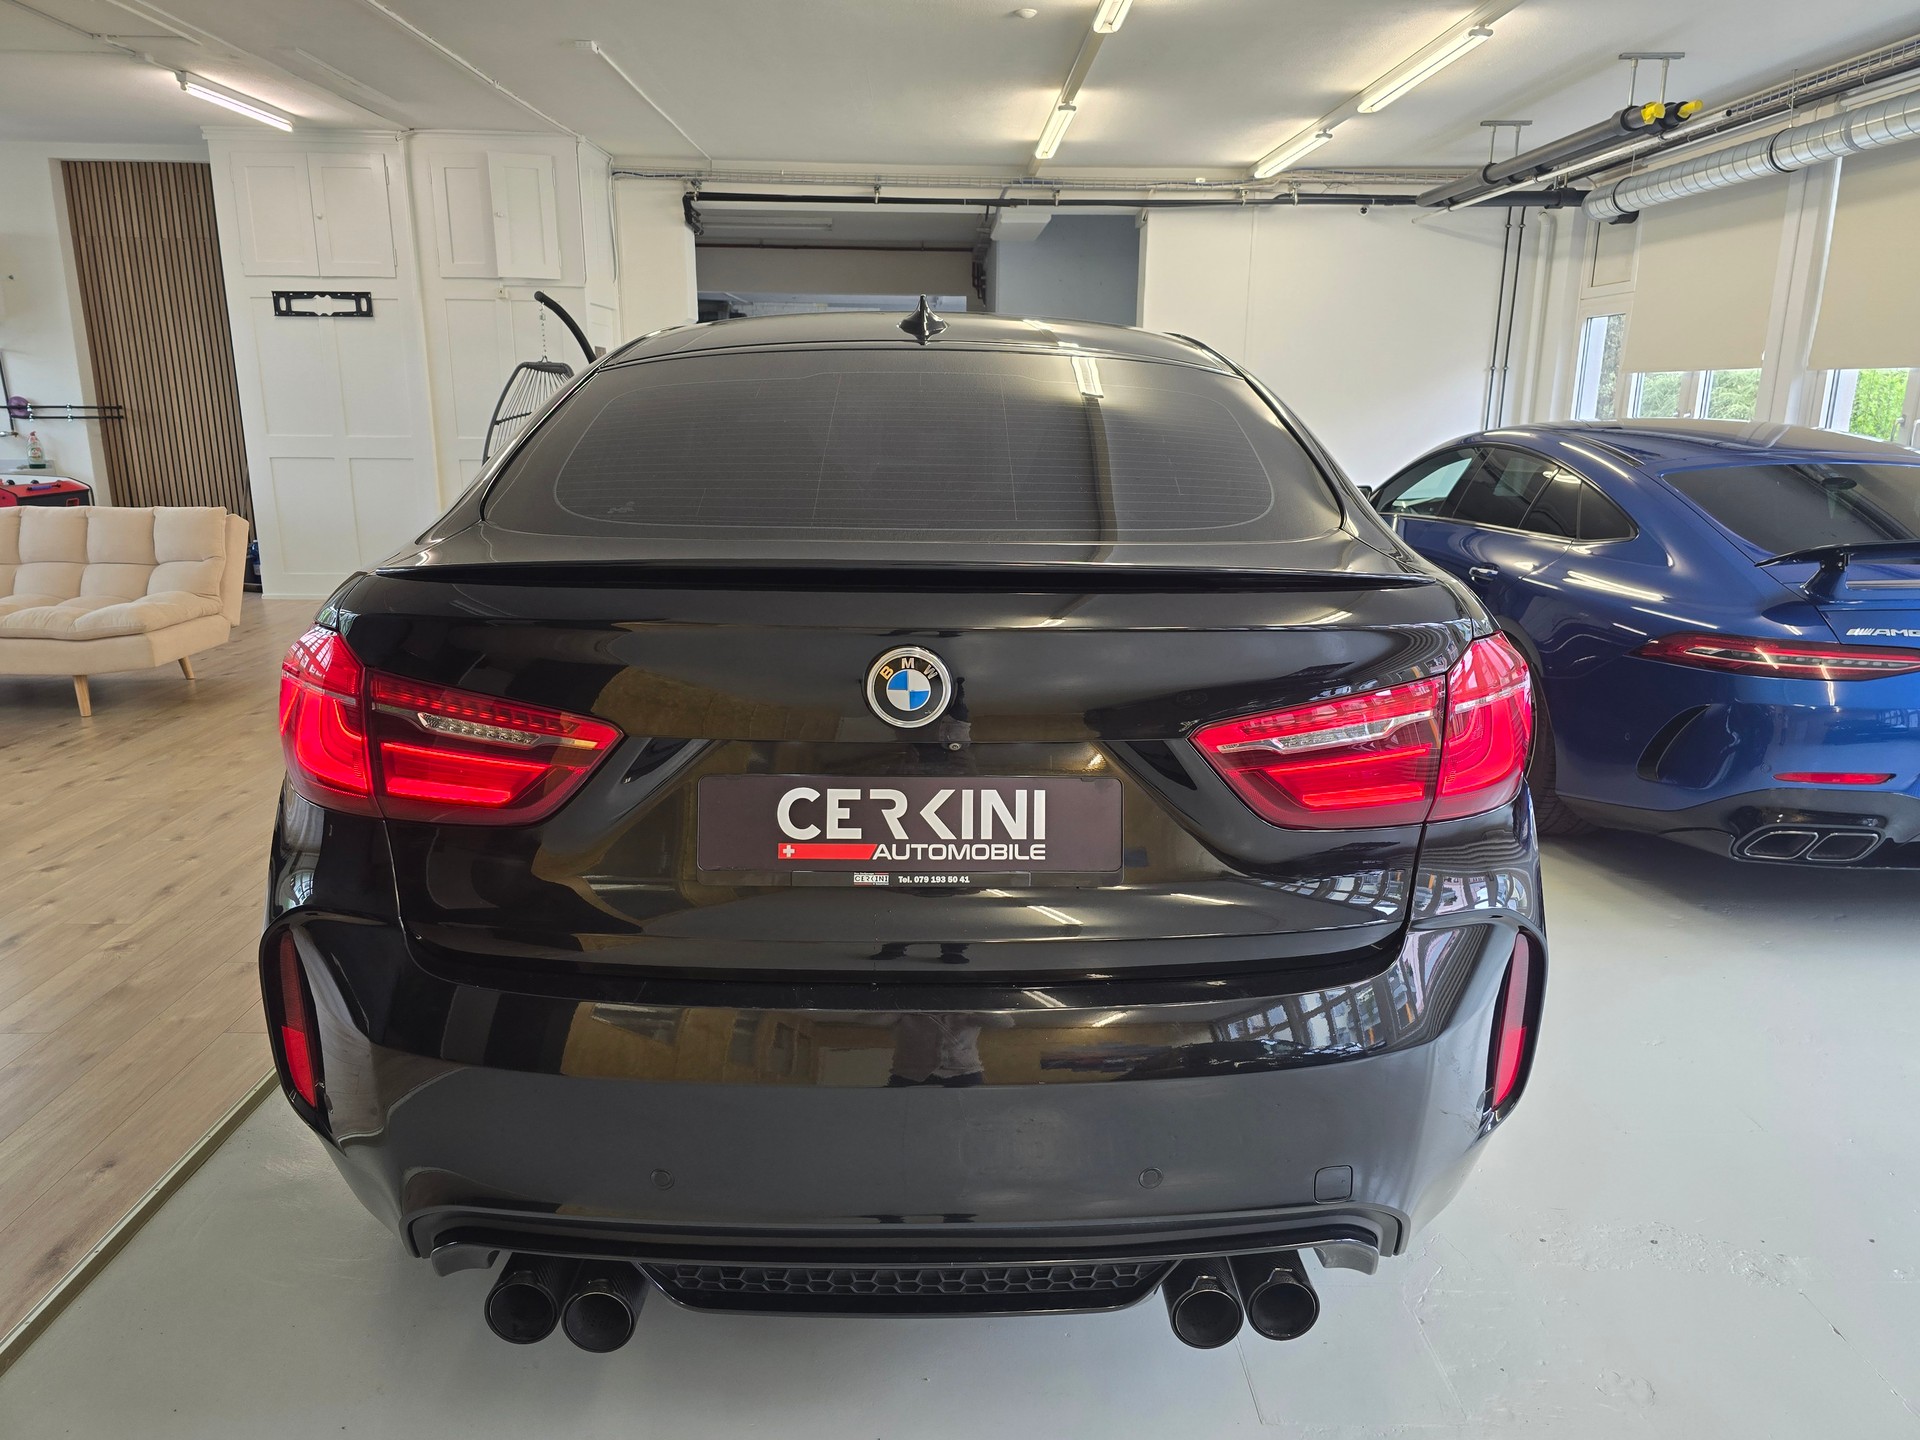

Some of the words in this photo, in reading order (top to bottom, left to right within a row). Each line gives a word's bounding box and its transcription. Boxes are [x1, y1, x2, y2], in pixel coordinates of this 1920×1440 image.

[880, 657, 938, 680] BMW
[777, 787, 1046, 840] CERKINI
[872, 843, 1046, 861] AUTOMOBILE
[898, 875, 912, 883] Tel.
[914, 875, 929, 883] 079
[931, 875, 946, 883] 193
[959, 875, 971, 883] 41
